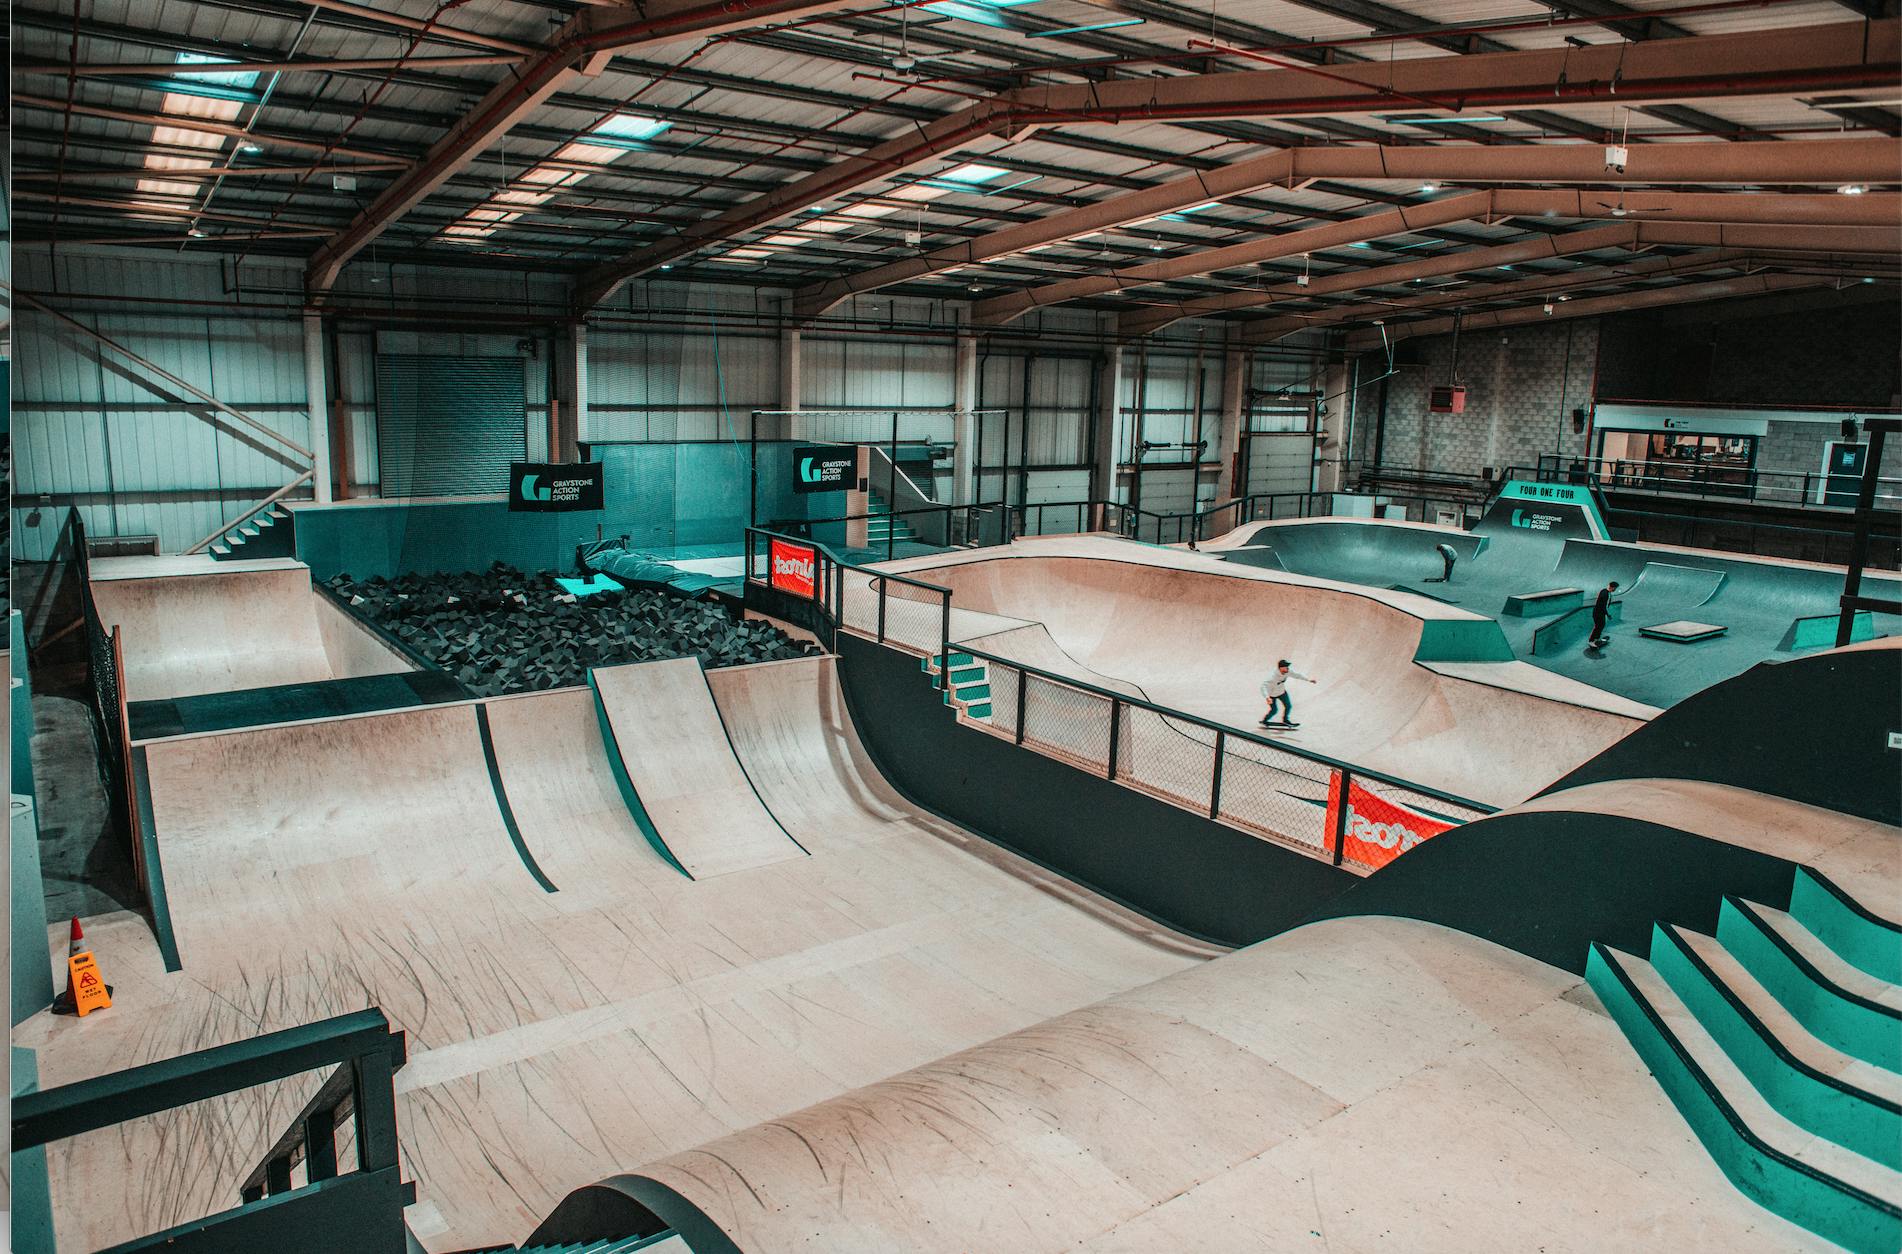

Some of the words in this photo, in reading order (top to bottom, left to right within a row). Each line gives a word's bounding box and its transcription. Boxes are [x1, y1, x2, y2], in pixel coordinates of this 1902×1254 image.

[822, 460, 851, 468] GRAYSTONE
[552, 479, 593, 487] GRAYSTONE
[1520, 486, 1537, 495] FOUR
[1540, 487, 1554, 497] ONE
[1556, 489, 1574, 499] FOUR
[1532, 513, 1562, 522] GRAYSTONE
[82, 990, 102, 999] FLOOR
